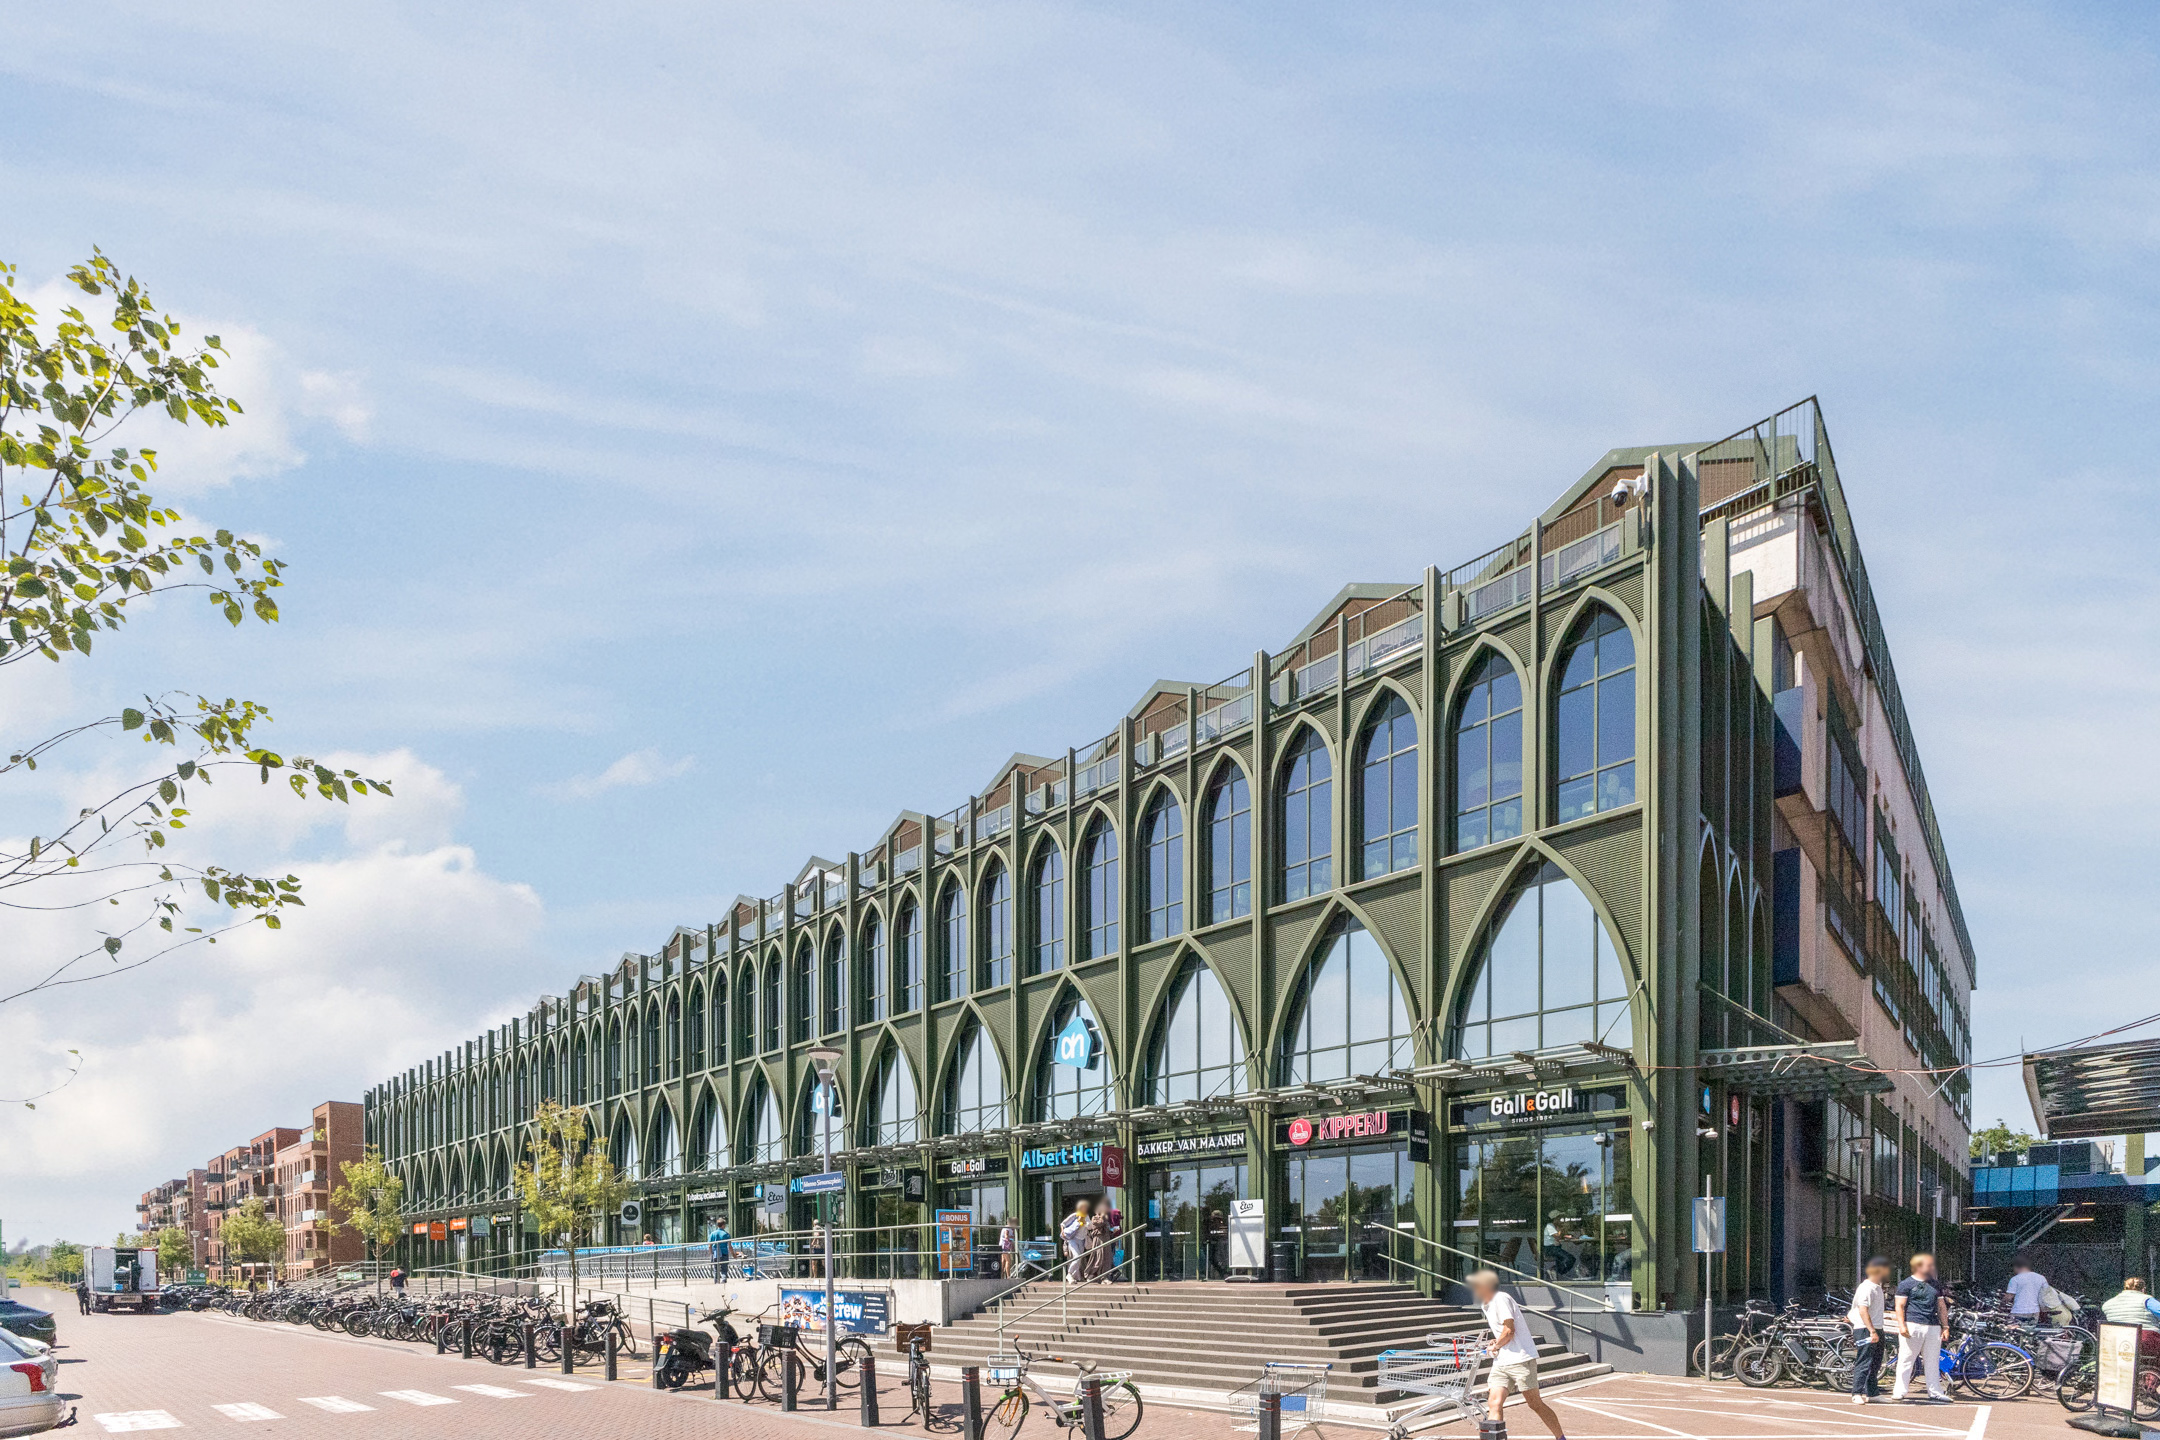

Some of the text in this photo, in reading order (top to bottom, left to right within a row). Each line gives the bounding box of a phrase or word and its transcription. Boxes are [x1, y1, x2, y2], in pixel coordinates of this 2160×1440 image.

[1319, 1111, 1388, 1140] KIPPERIJ
[1511, 1116, 1534, 1124] SINDS
[1138, 1132, 1244, 1156] BAKKER VAN MAANEN
[1021, 1142, 1103, 1169] Albert Heij
[767, 1191, 784, 1203] Etos
[1240, 1201, 1254, 1211] Etos
[945, 1214, 968, 1222] BONUS
